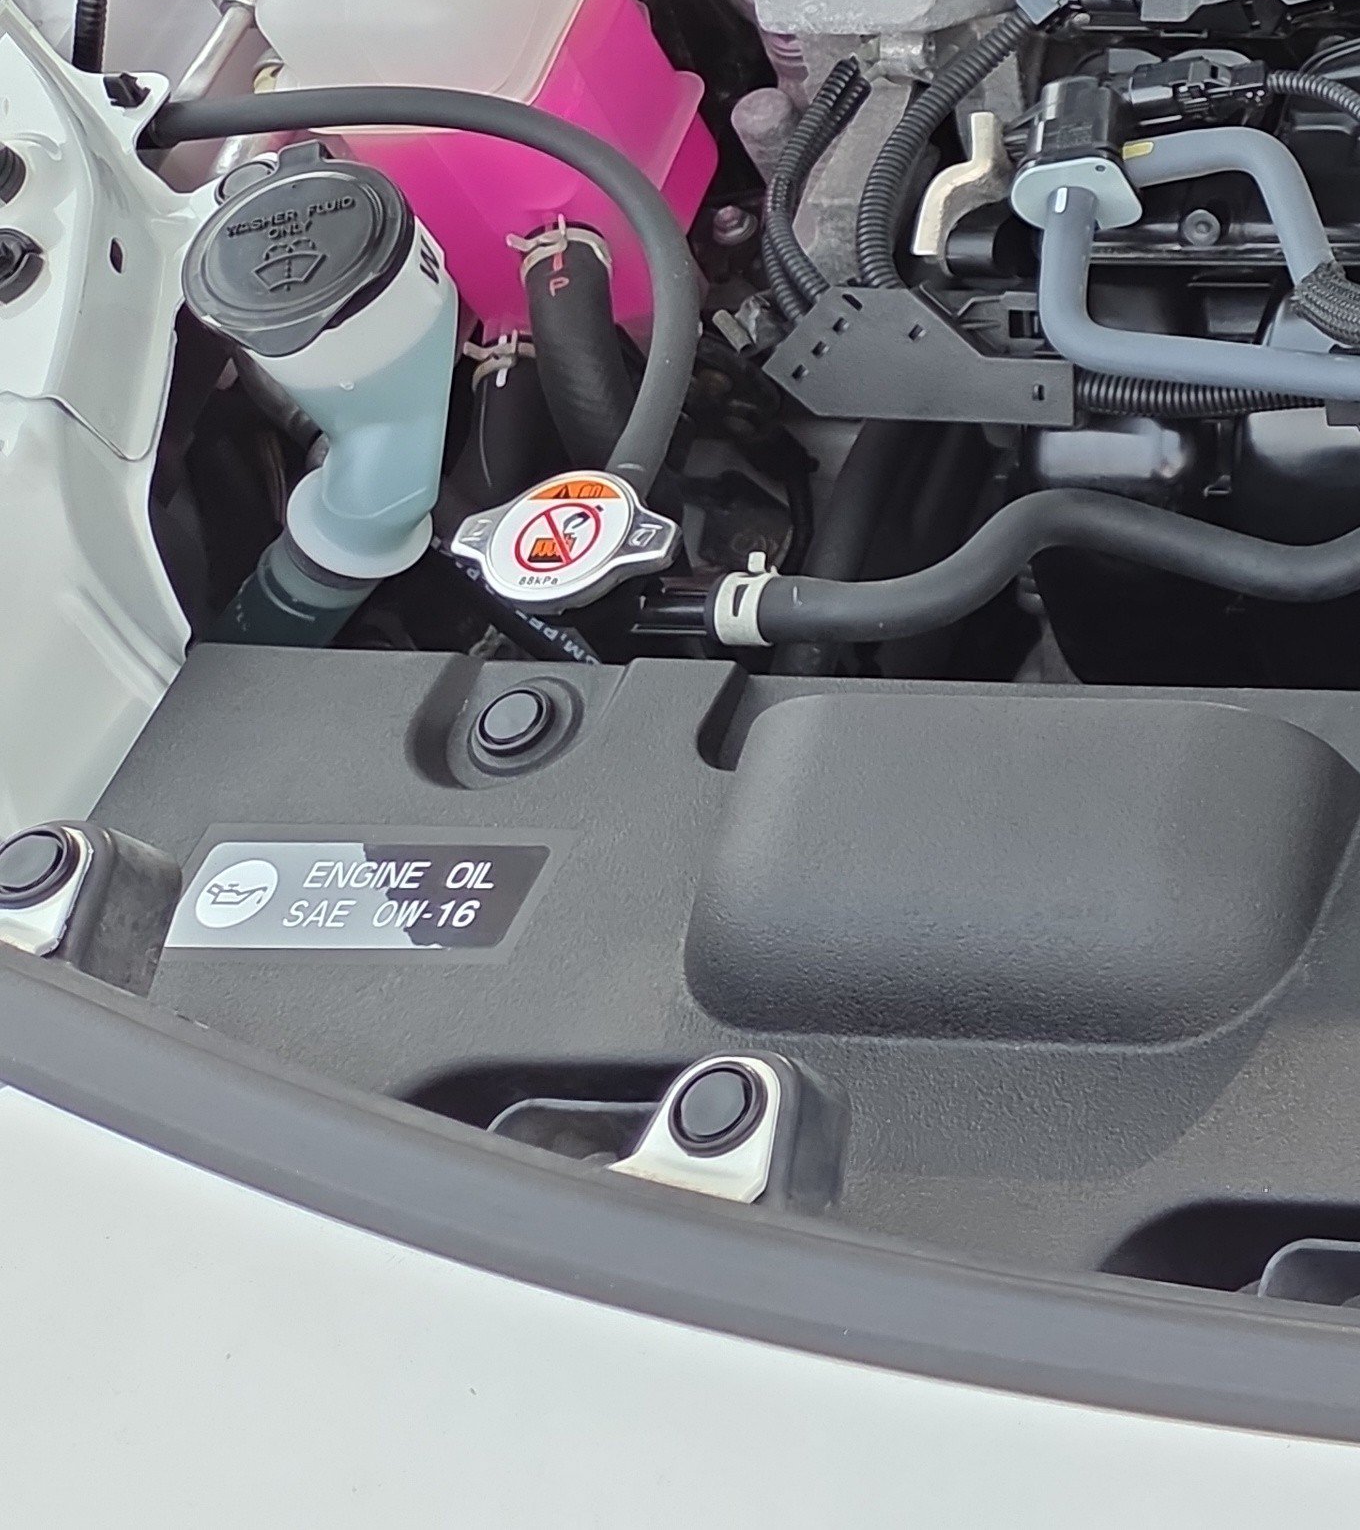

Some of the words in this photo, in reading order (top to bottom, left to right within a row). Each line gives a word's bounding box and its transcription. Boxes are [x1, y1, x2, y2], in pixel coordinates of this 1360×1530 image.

[226, 210, 298, 238] WASHER
[306, 196, 357, 218] FLUID
[268, 220, 313, 240] ONLY
[549, 276, 570, 298] P
[518, 576, 559, 586] 88kPa
[302, 861, 432, 890] ENGINE
[445, 861, 495, 890] OIL
[282, 900, 357, 929] SAE
[371, 900, 482, 929] 0W-16
